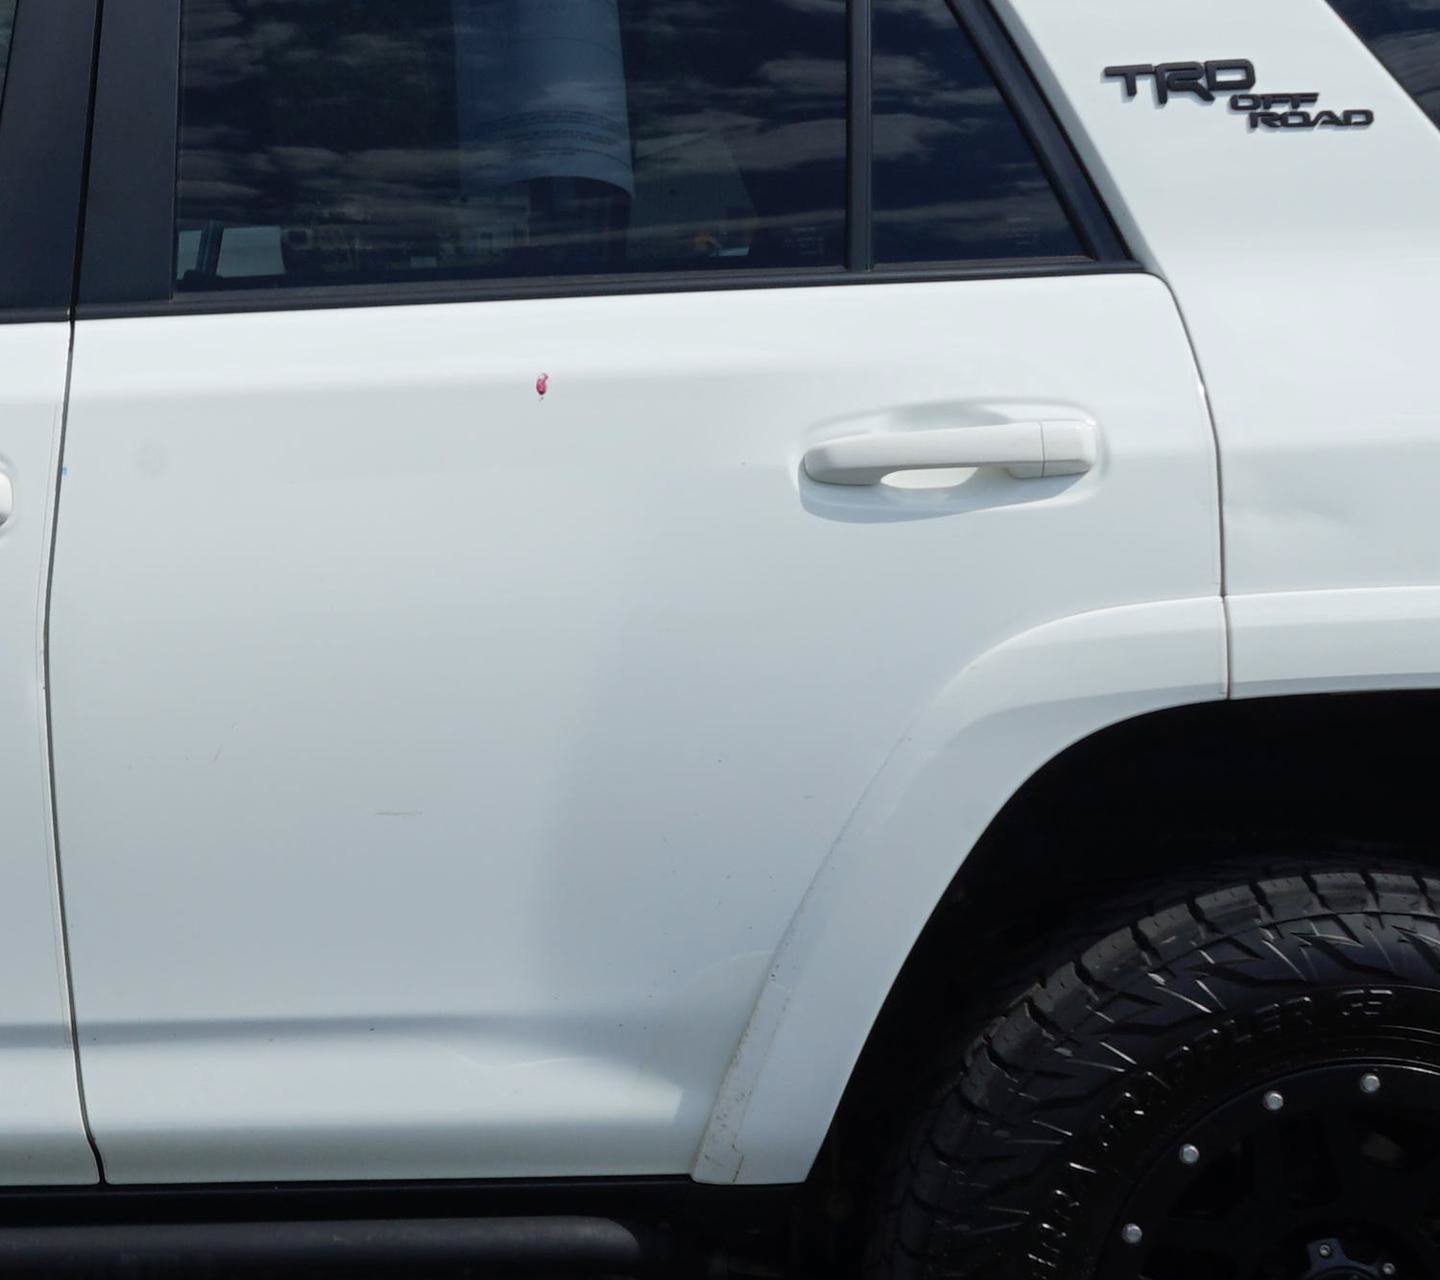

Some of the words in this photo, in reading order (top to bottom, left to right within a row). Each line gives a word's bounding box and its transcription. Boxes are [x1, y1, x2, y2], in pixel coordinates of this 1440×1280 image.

[1103, 58, 1256, 105] TRD
[1229, 92, 1319, 112] OFF
[1248, 108, 1374, 130] ROAD
